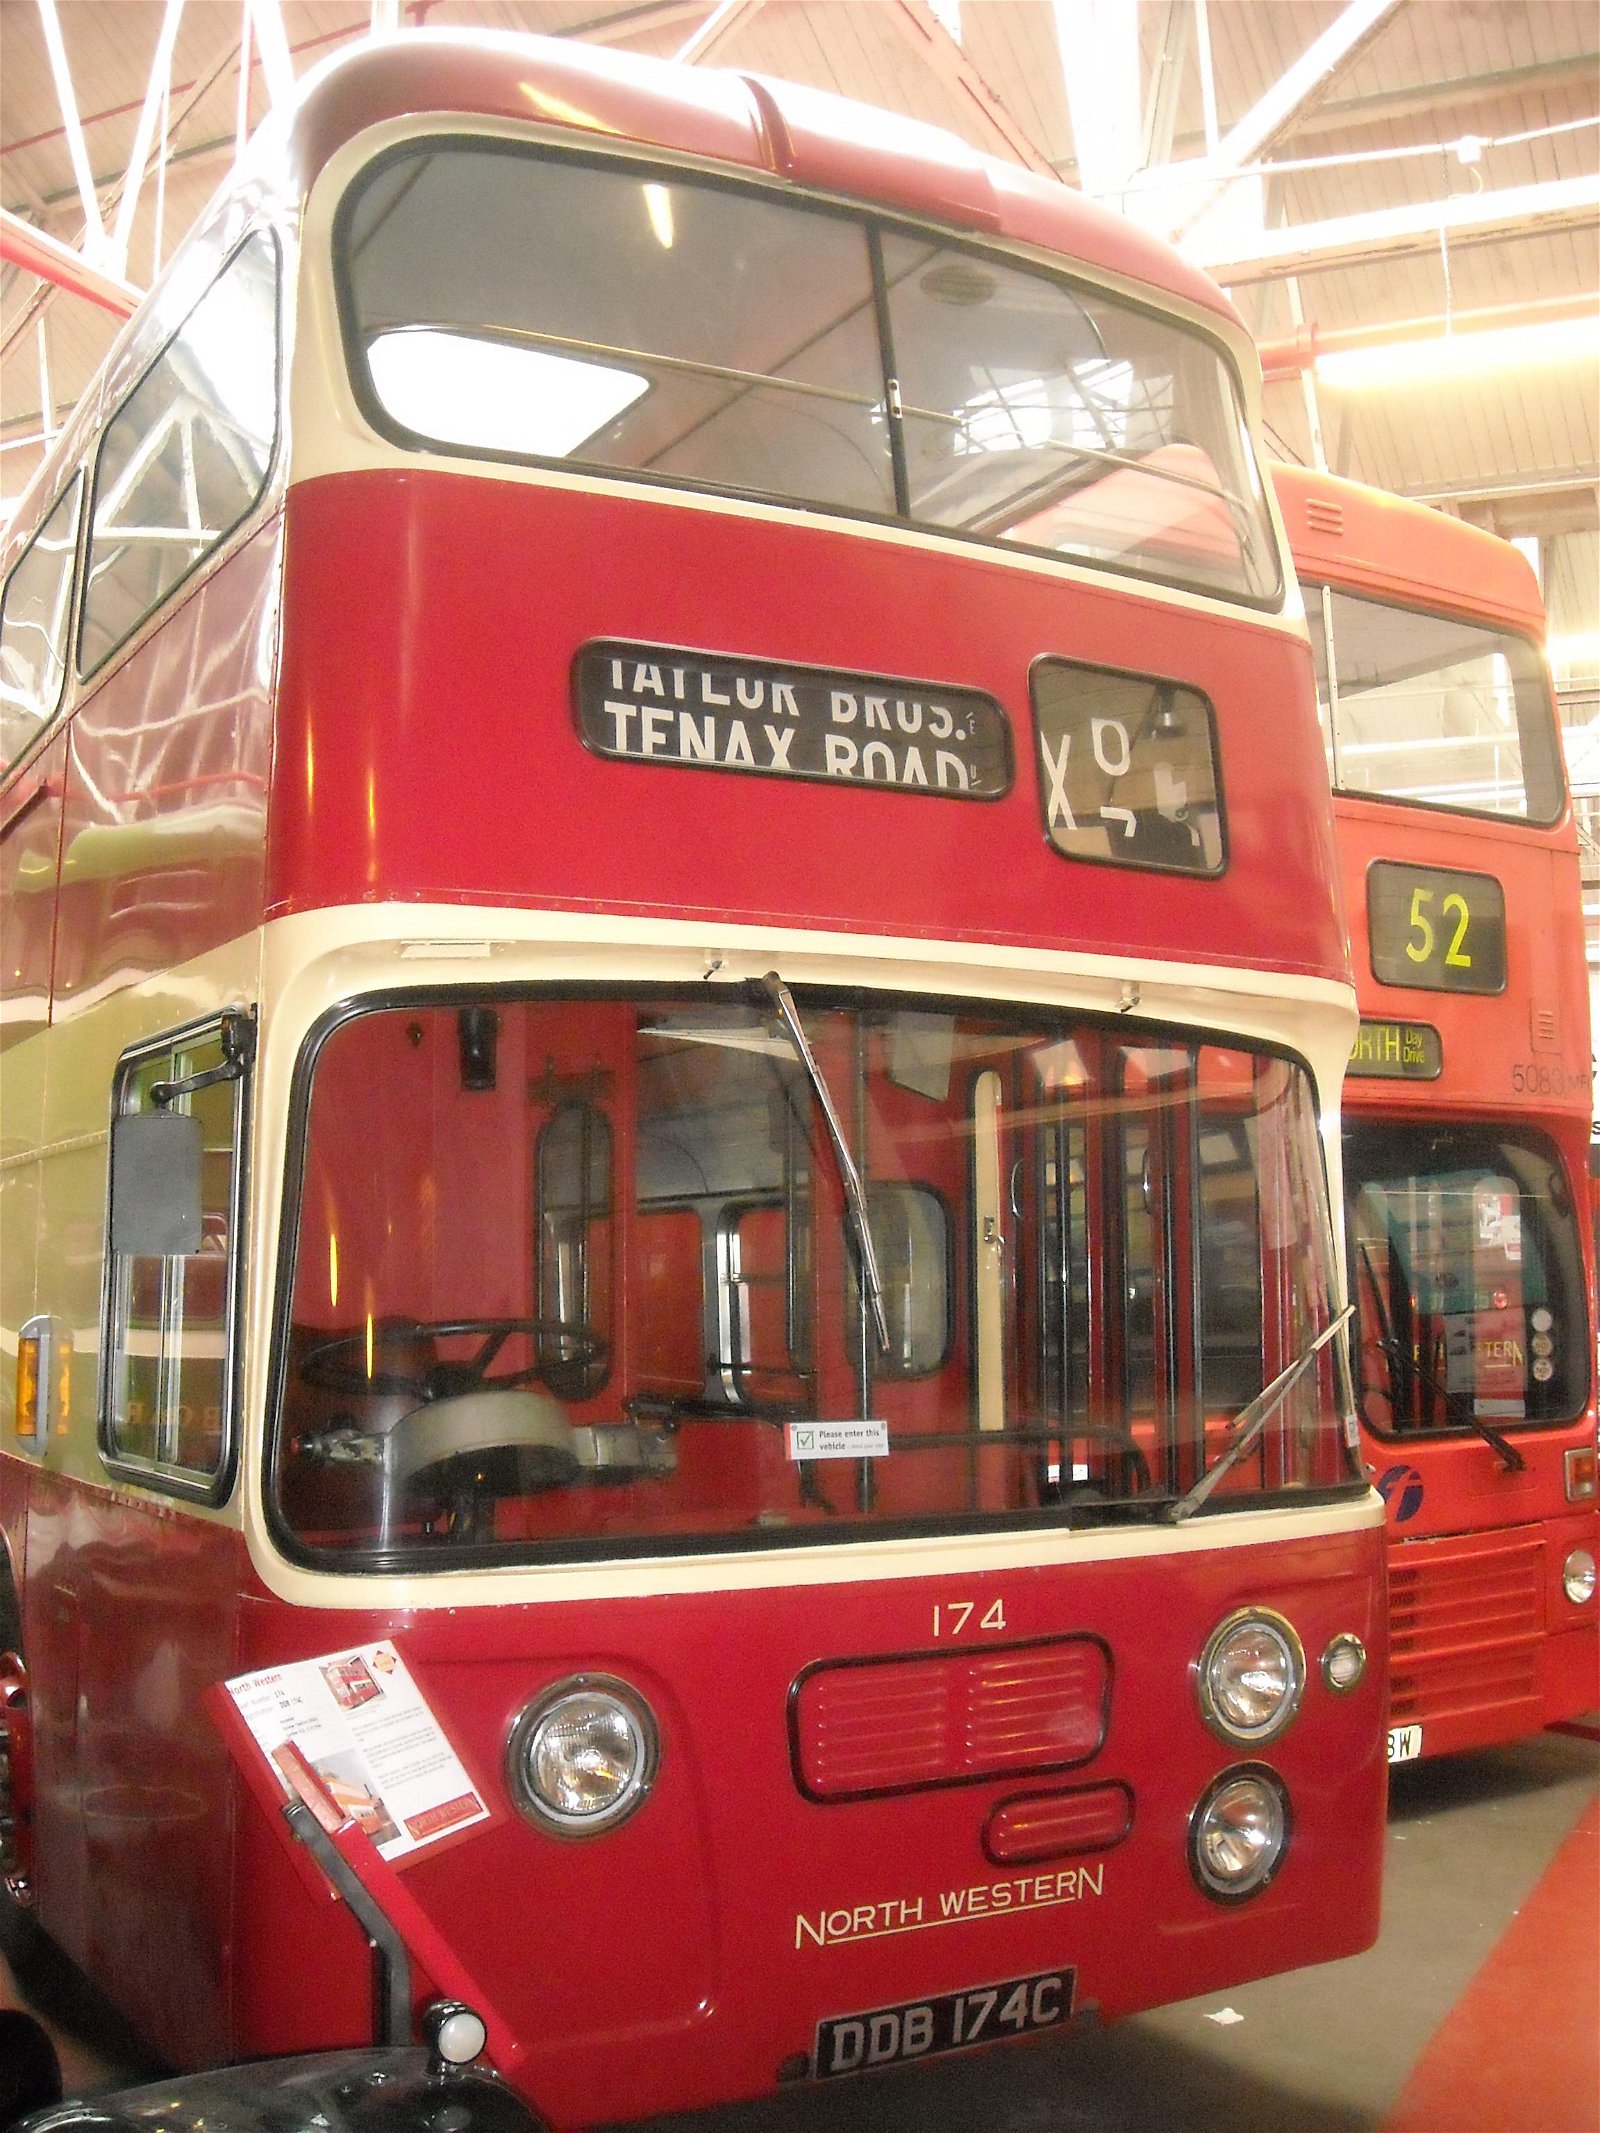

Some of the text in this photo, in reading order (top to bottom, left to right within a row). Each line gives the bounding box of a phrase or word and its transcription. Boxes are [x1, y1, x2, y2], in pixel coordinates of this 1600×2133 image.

[604, 700, 796, 770] TENAX
[824, 733, 970, 791] ROAD
[1405, 888, 1471, 968] 52
[819, 1429, 880, 1439] Please enter this
[819, 1441, 846, 1451] vehicle
[933, 1599, 1007, 1637] 174
[795, 1864, 1103, 1950] NORTH WESTERN
[830, 1977, 1062, 2072] DDB 174C
